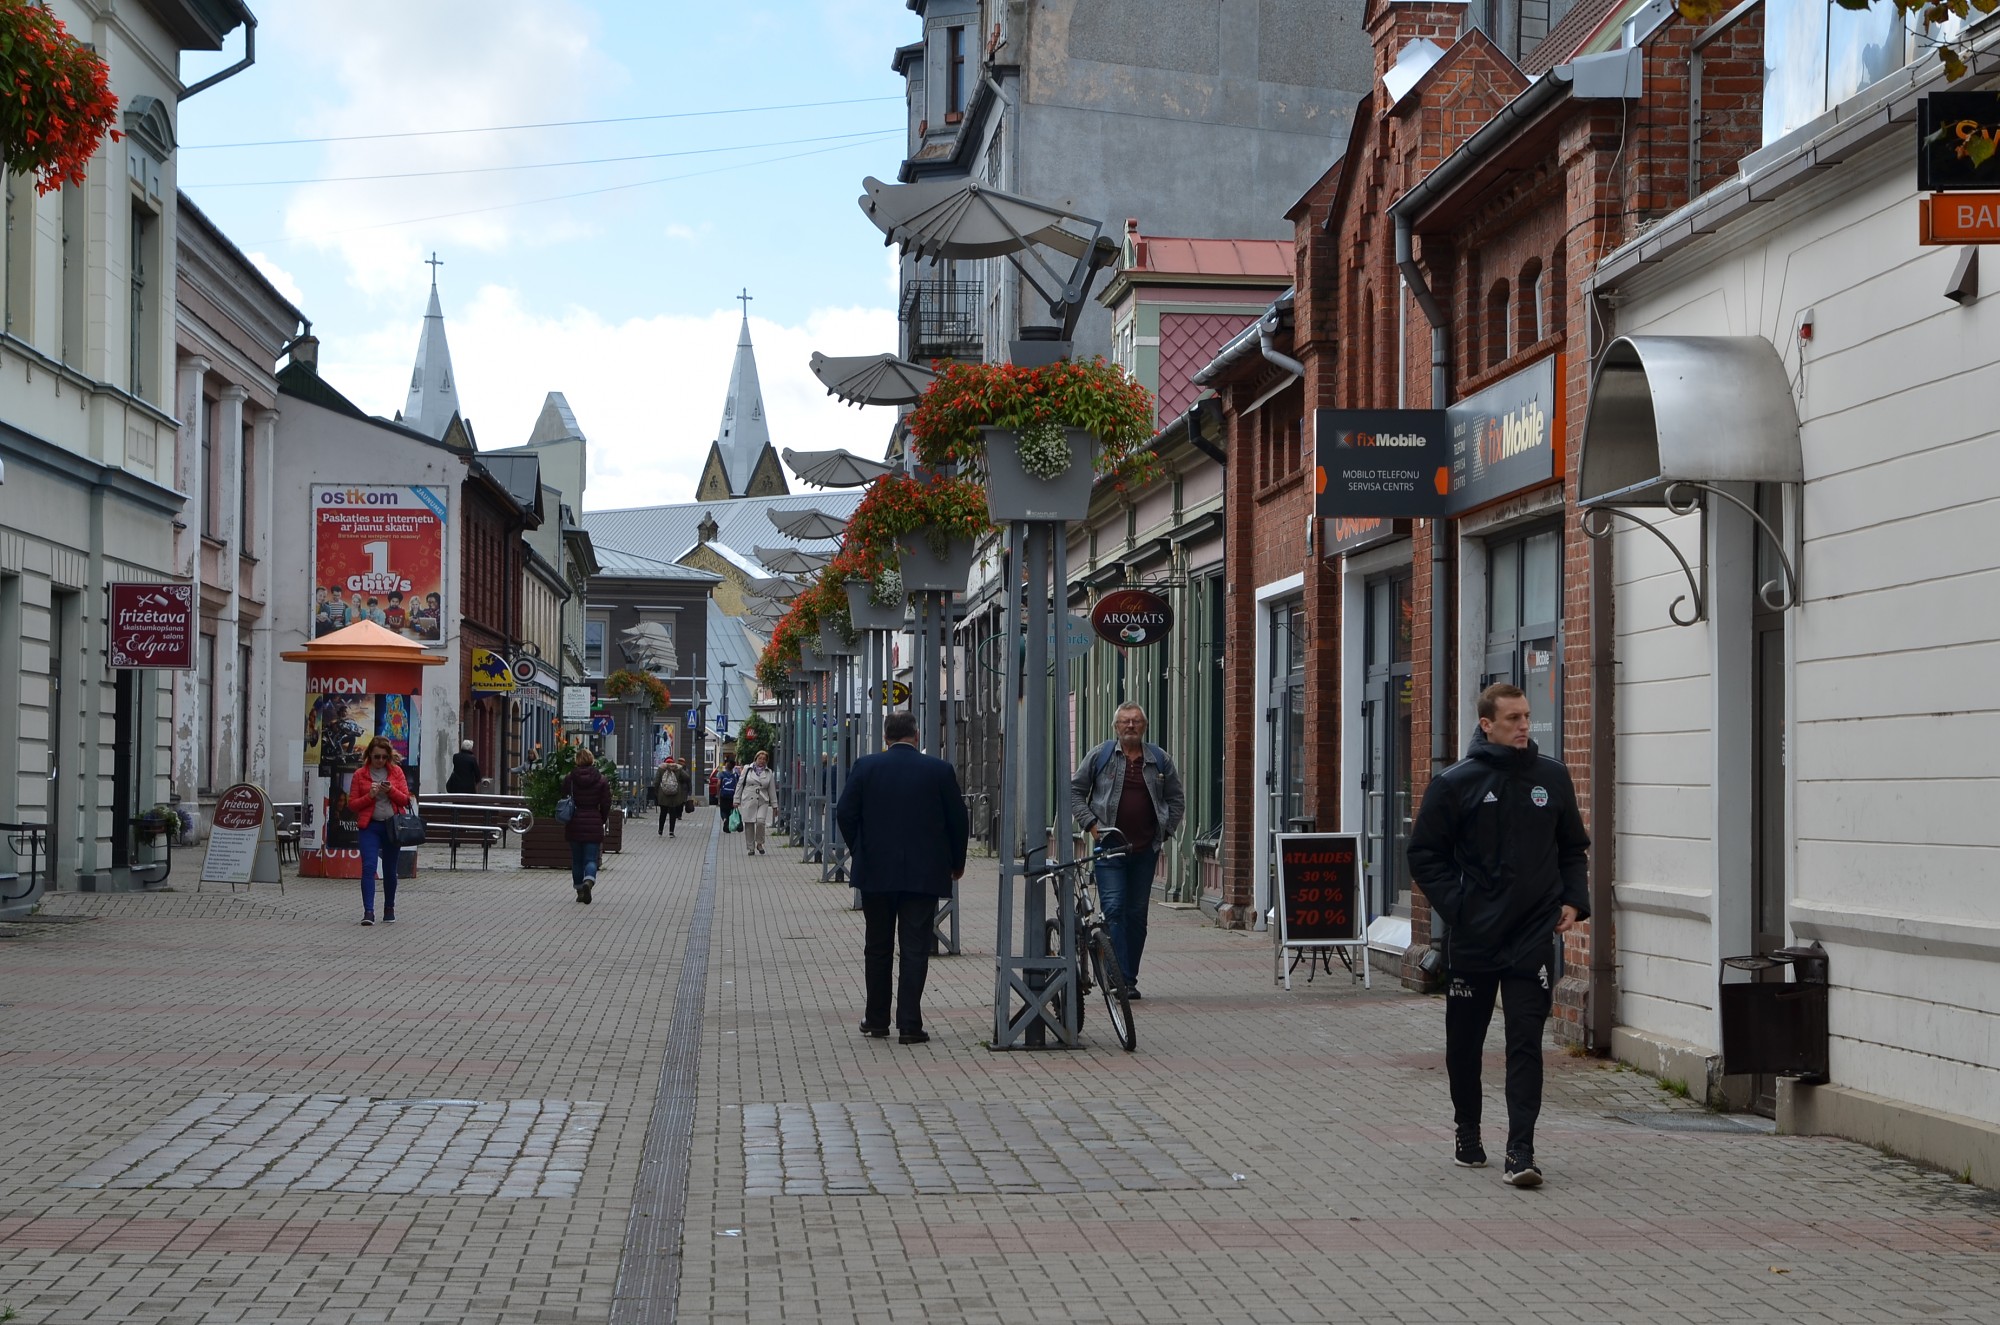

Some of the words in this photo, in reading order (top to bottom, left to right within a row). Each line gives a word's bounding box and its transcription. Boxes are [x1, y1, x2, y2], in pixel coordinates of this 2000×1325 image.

[1957, 205, 2000, 229] BA
[1356, 433, 1427, 447] fixMobile
[1487, 401, 1545, 466] fixMobile
[1342, 470, 1376, 479] MOBILO
[1377, 470, 1420, 479] TELEFONU
[1348, 482, 1381, 491] SERVISA
[1382, 482, 1414, 491] CENTRS
[320, 489, 398, 505] ostkom
[322, 513, 370, 523] Paskaties
[372, 515, 385, 523] uz
[387, 514, 434, 524] internetu
[340, 524, 351, 532] ar
[353, 523, 383, 533] jaunu
[385, 524, 413, 532] skatu
[362, 541, 396, 579] 1
[347, 573, 412, 592] Gbit/s
[119, 608, 185, 625] frizētava
[1102, 612, 1164, 624] AROMĀTS
[122, 624, 184, 632] skaistumkopšanas
[117, 633, 184, 659] Edgars
[222, 800, 260, 810] frizētava
[1284, 852, 1353, 864] ATLAIDES
[1323, 871, 1337, 881] %
[1291, 888, 1320, 903] -50
[1324, 888, 1343, 902] %
[1287, 910, 1320, 925] -70
[1324, 910, 1347, 925] %
